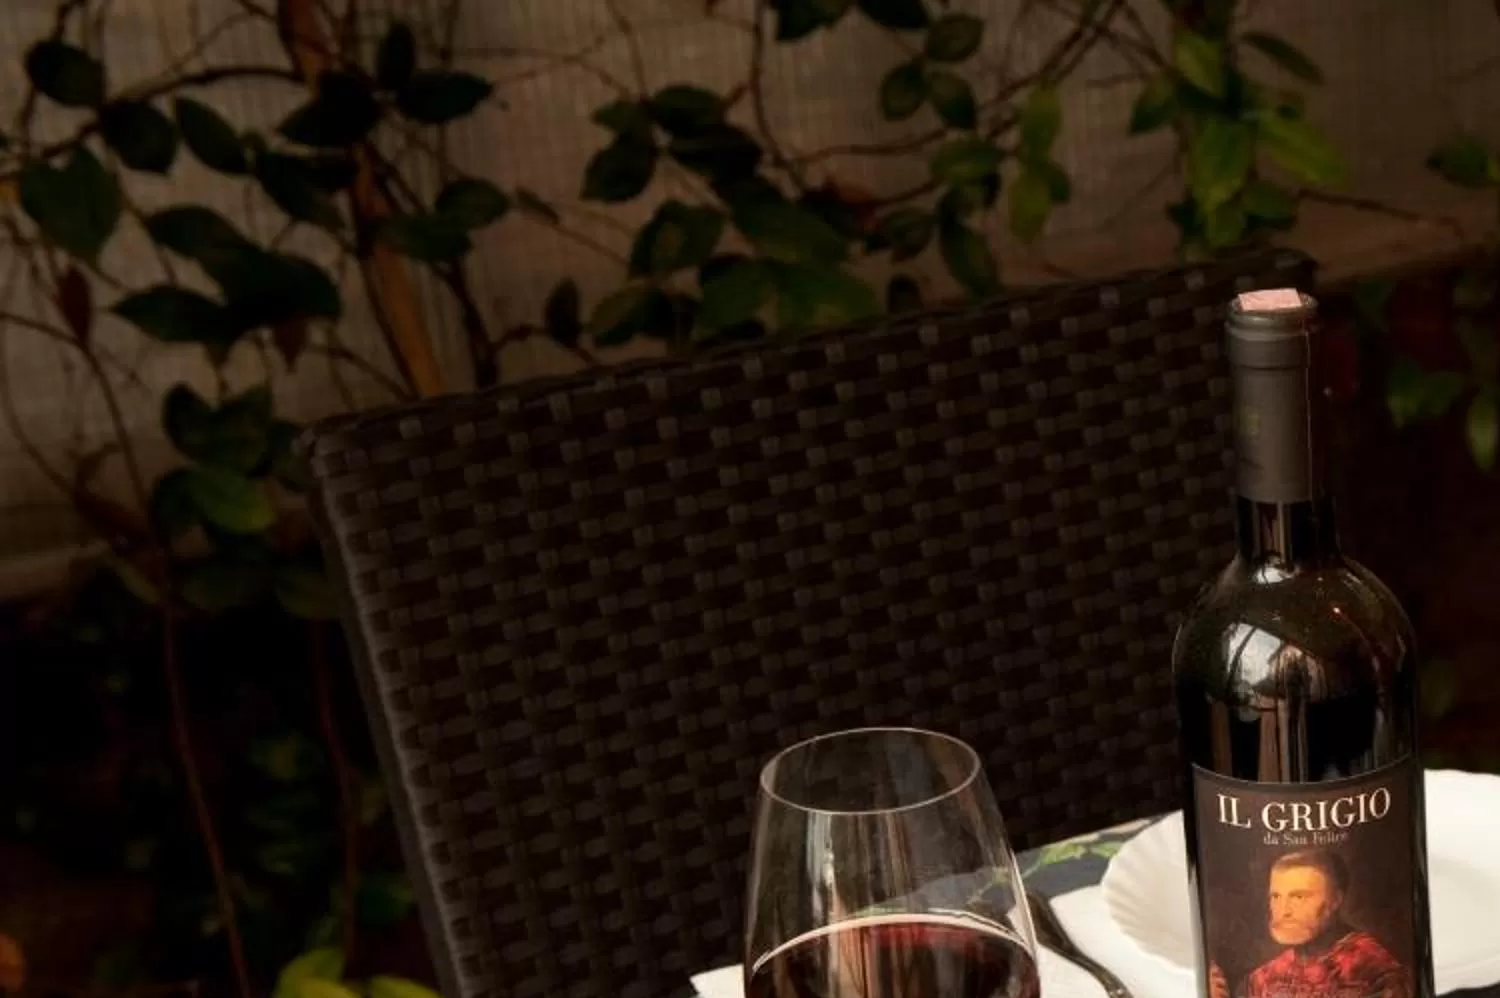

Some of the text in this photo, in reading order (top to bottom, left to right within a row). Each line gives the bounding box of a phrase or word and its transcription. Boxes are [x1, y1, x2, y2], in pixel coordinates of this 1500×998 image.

[1217, 787, 1391, 832] IL GRIGIO
[1263, 830, 1349, 845] da San Felice
